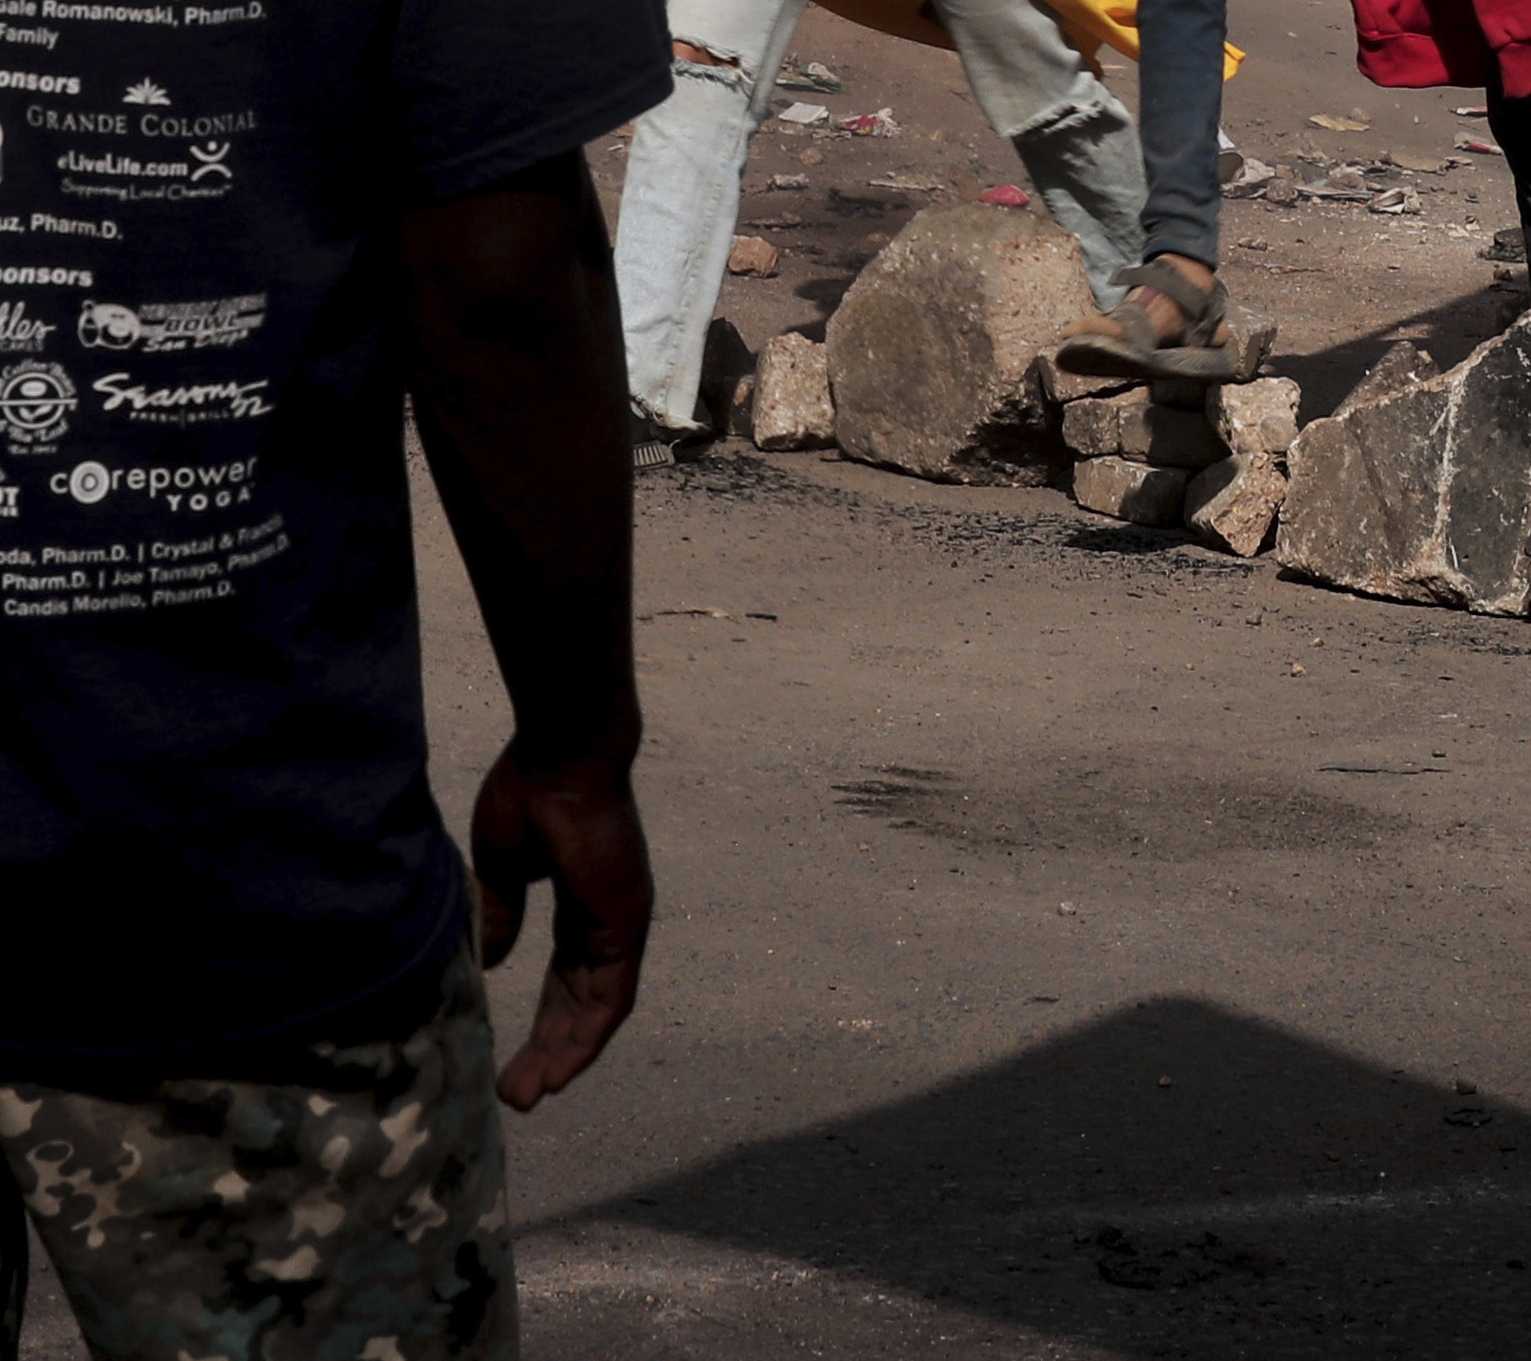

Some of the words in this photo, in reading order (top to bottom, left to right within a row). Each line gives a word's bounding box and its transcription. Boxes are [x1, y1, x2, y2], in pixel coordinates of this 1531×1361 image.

[42, 0, 179, 27] Romanowski,
[184, 1, 266, 26] Pharm.D.
[26, 105, 128, 135] GRANDE
[140, 110, 258, 138] COLONIAL
[57, 150, 188, 177] eLiveLife.com
[31, 213, 123, 240] Pharm.D.
[49, 455, 257, 504] corepower
[166, 485, 250, 512] YOGA
[42, 544, 129, 565] Pharm.D.
[151, 536, 214, 560] Crystal
[1, 571, 91, 592] Pharm.D.
[112, 571, 144, 587] Joe
[4, 598, 68, 617] Candis
